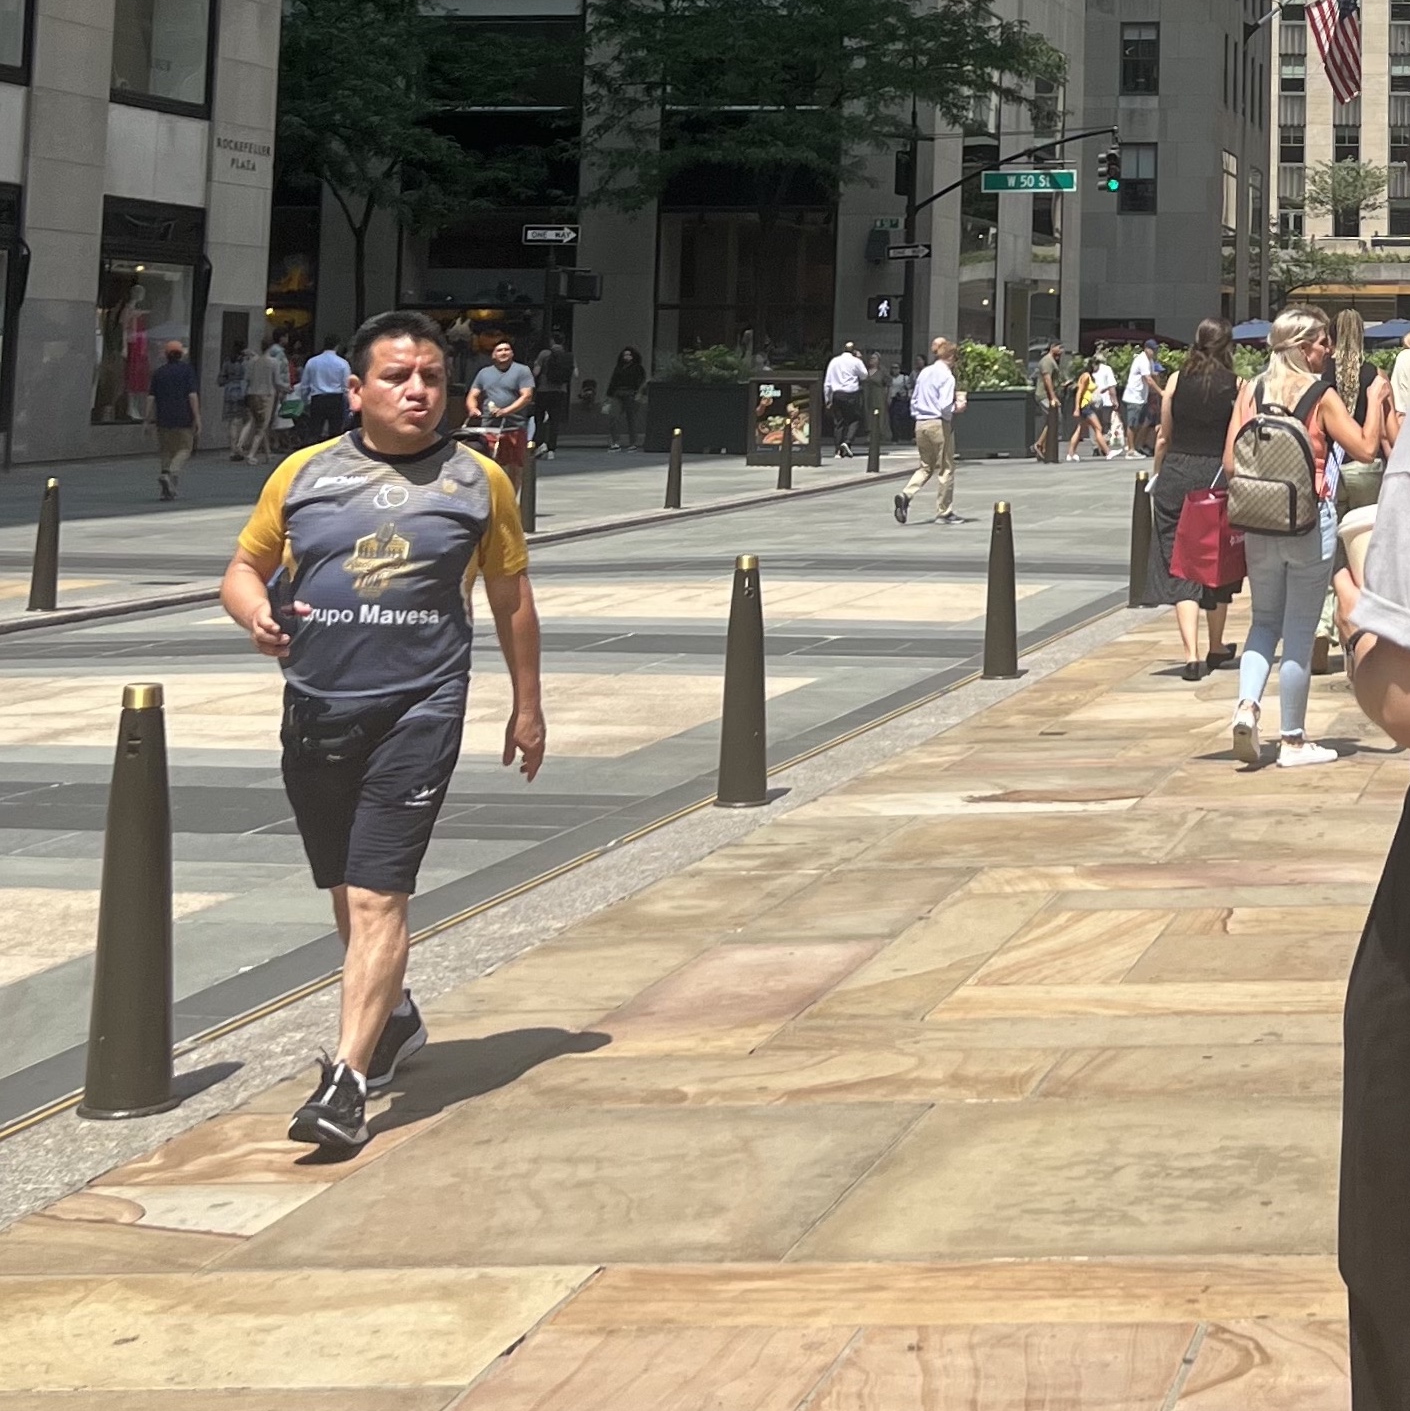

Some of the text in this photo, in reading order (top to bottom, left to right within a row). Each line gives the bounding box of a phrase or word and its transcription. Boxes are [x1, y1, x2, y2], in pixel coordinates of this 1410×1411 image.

[1006, 174, 1051, 187] W 50 St
[359, 604, 440, 625] Mavesa
